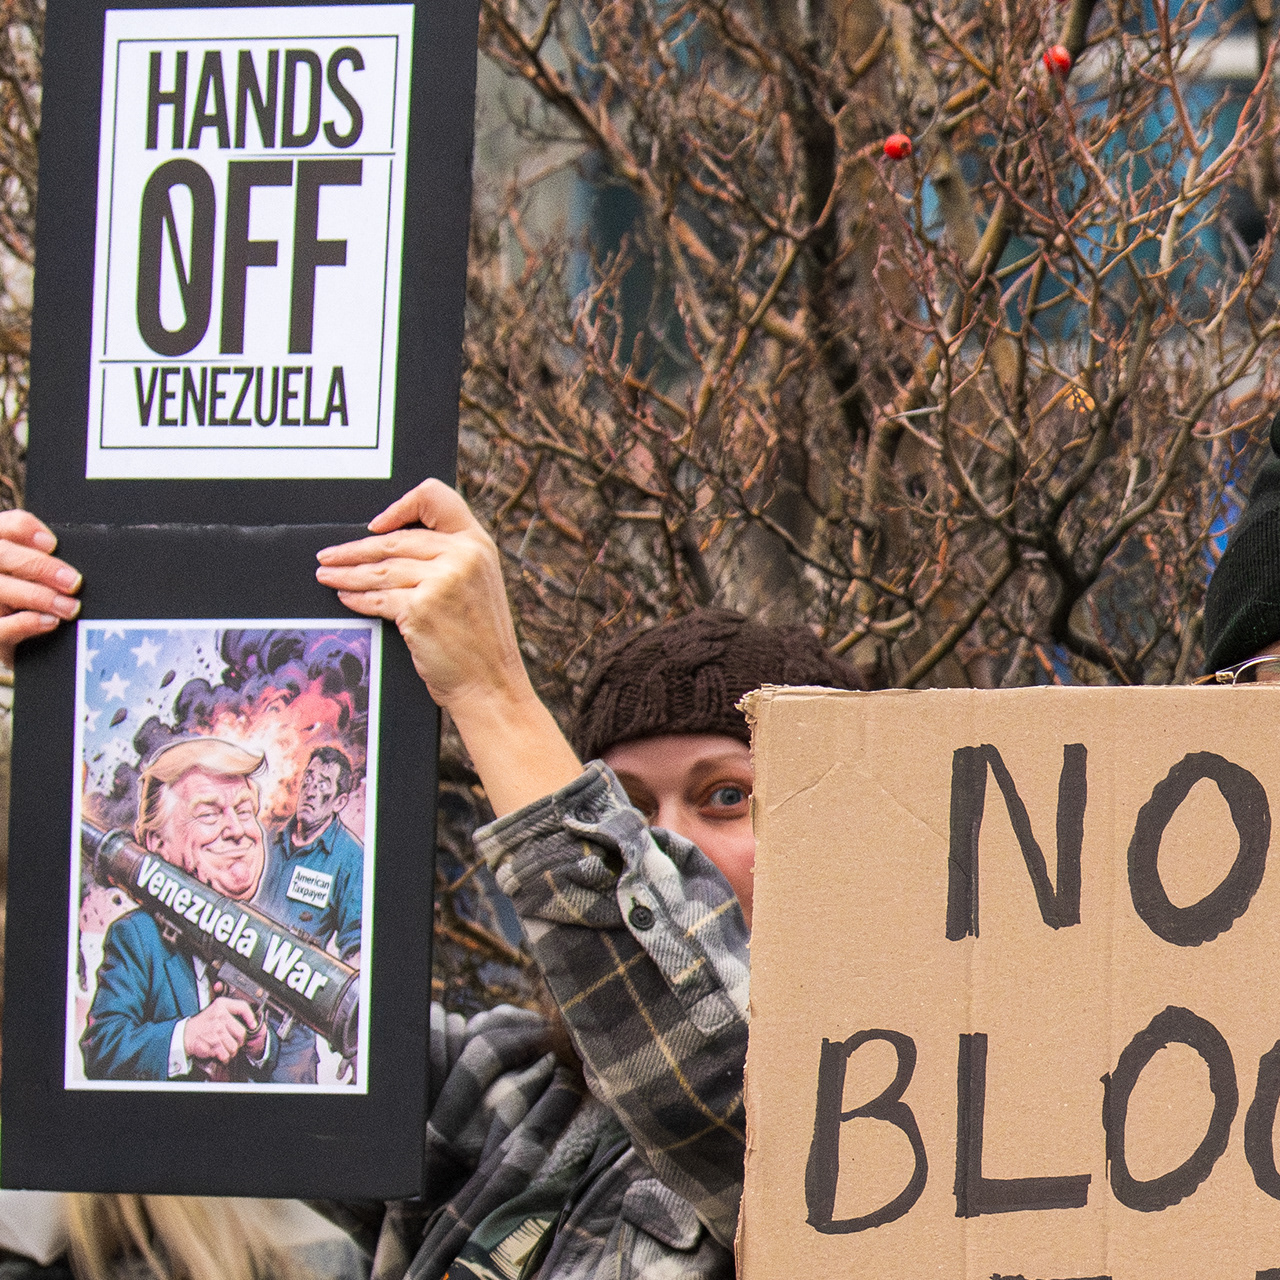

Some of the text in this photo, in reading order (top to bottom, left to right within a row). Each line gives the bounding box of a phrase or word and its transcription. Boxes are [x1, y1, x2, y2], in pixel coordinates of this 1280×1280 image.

[145, 46, 366, 150] HANDS
[136, 157, 363, 357] OFF
[134, 365, 349, 427] VENEZUELA
[291, 881, 326, 901] Taxpayer
[295, 870, 331, 890] American
[945, 742, 1272, 947] NO
[136, 856, 329, 1000] Venezuela War
